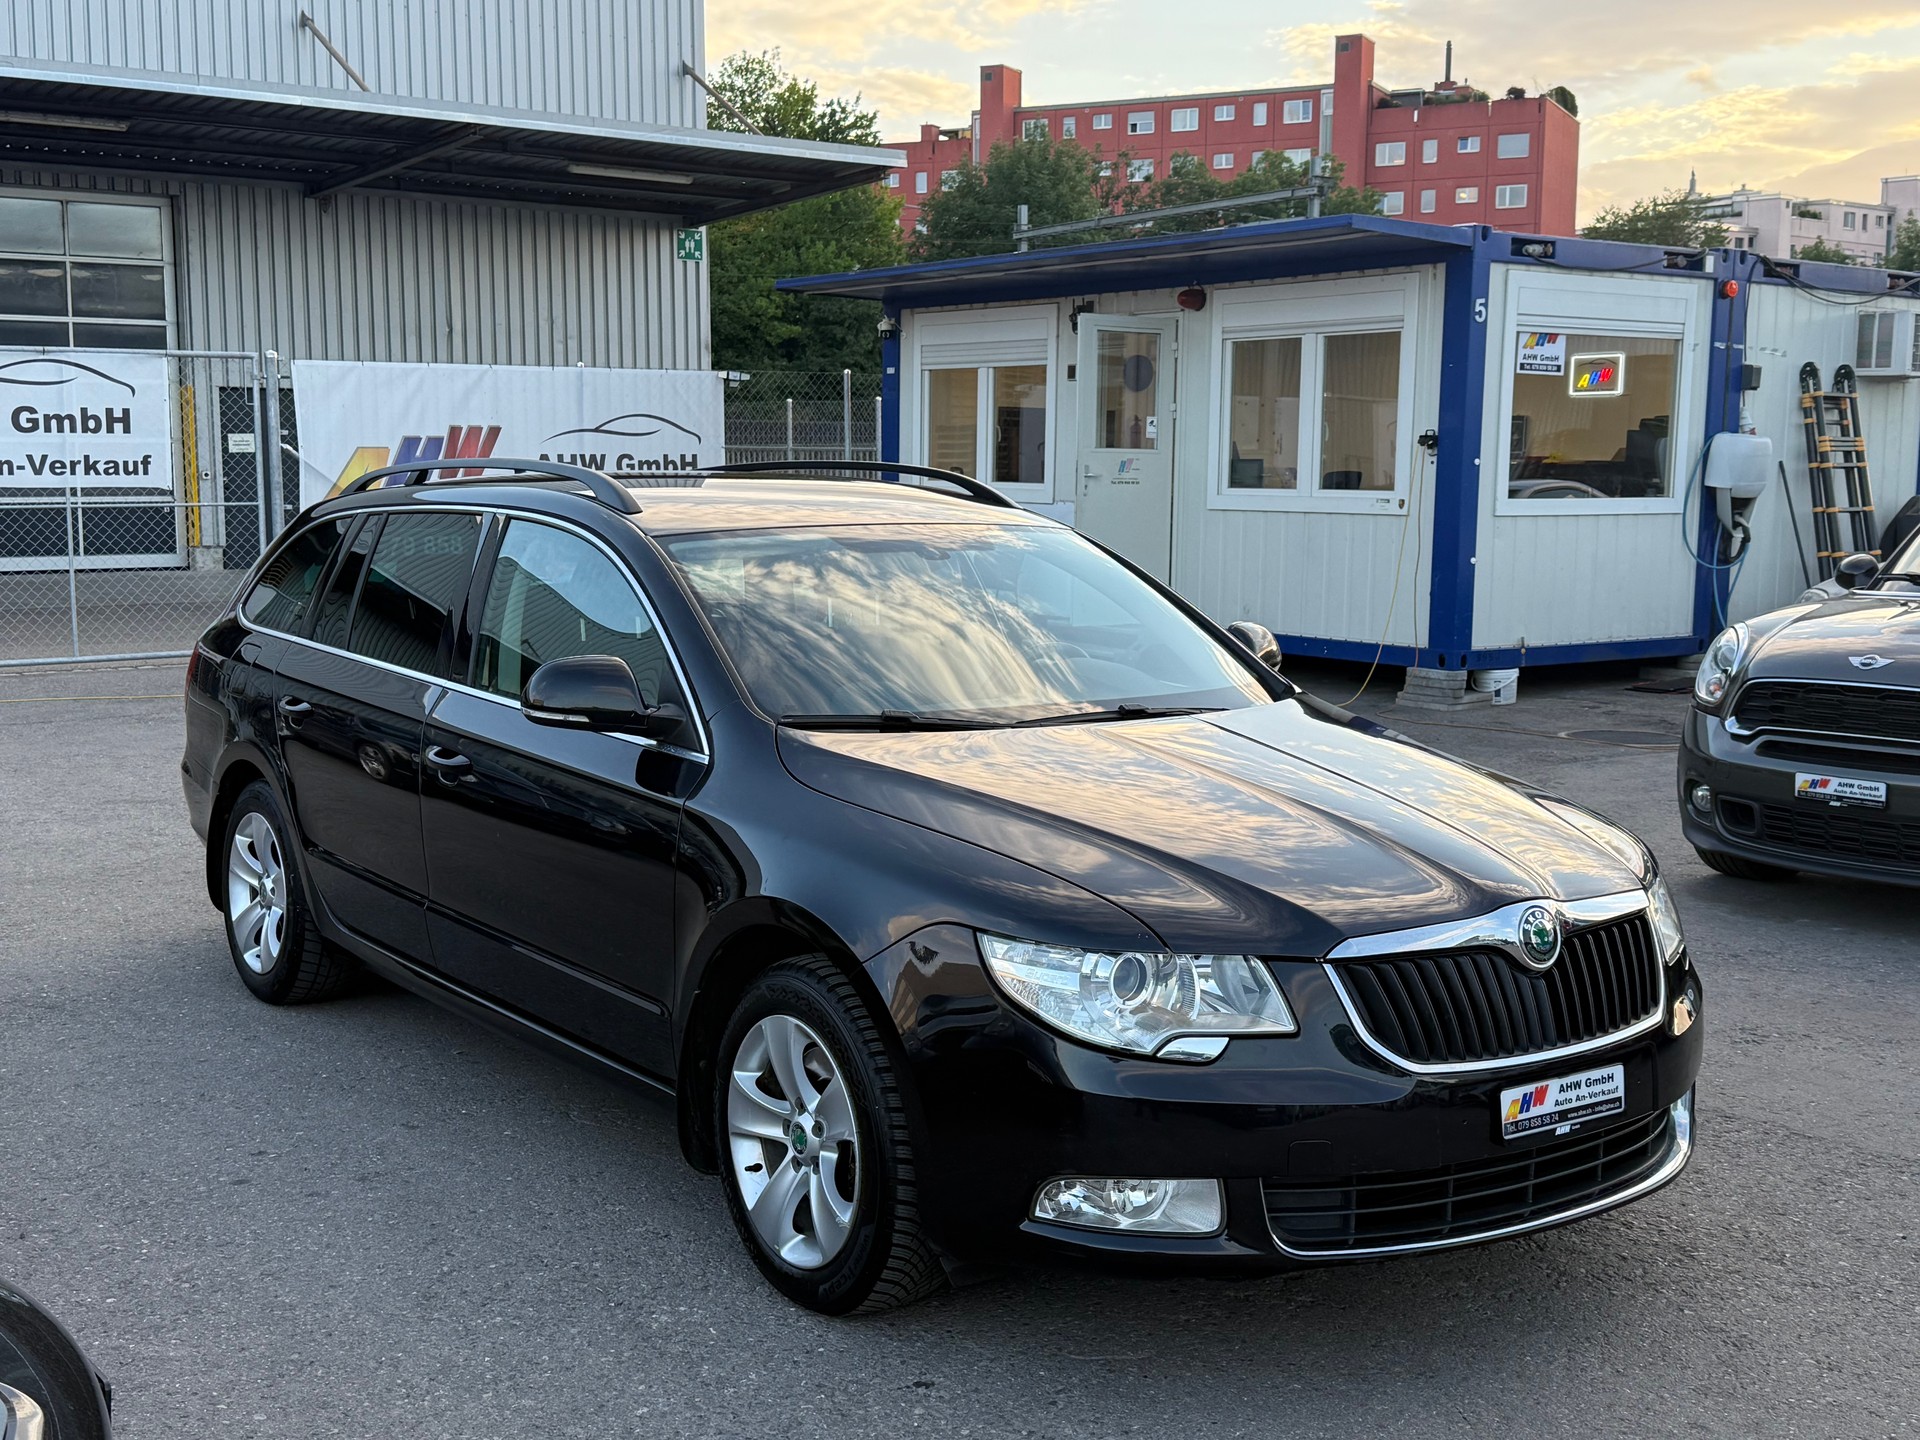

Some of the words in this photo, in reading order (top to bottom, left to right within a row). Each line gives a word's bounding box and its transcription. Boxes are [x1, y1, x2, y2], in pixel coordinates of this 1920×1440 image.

[1474, 297, 1487, 323] 5
[1522, 353, 1539, 361] AHW
[1540, 354, 1560, 363] GmbH
[1577, 367, 1614, 388] AHW
[11, 405, 131, 434] GmbH
[616, 453, 698, 471] GmbH
[1837, 781, 1855, 789] AHW
[1857, 784, 1880, 792] GmbH
[1559, 1080, 1582, 1095] AHW
[1585, 1073, 1614, 1088] GmbH
[1504, 1084, 1549, 1122] AHW
[1554, 1097, 1573, 1107] Auto
[1575, 1085, 1619, 1102] An-Verkauf
[1518, 1120, 1530, 1130] 079
[1551, 1112, 1559, 1122] 24
